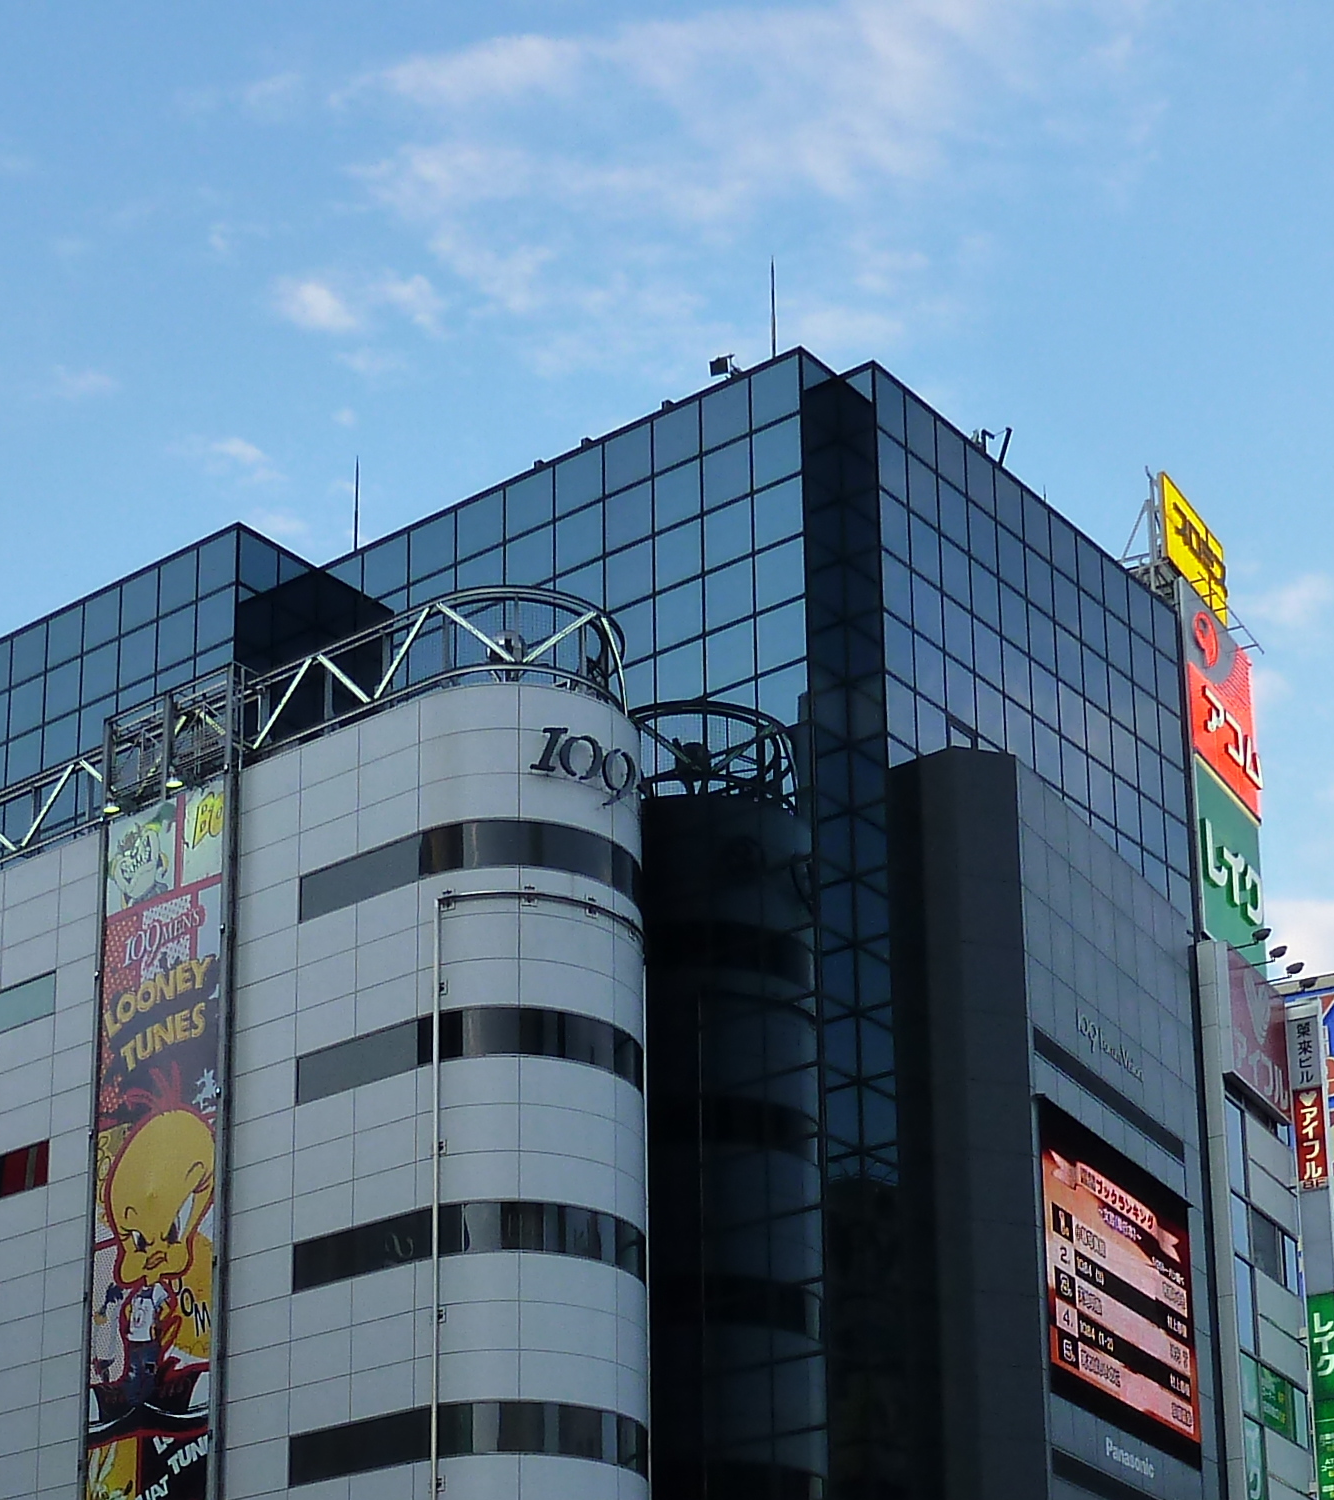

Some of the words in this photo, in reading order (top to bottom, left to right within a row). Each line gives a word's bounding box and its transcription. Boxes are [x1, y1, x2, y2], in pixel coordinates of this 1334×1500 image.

[529, 727, 636, 807] 109
[1202, 684, 1264, 789] アコム
[1200, 817, 1264, 926] レイク
[104, 956, 214, 1037] LOONEY
[119, 1001, 208, 1073] TUNES
[1299, 1108, 1323, 1180] アイフル
[1313, 1313, 1334, 1377] レイク
[1105, 1437, 1155, 1479] Panasonic
